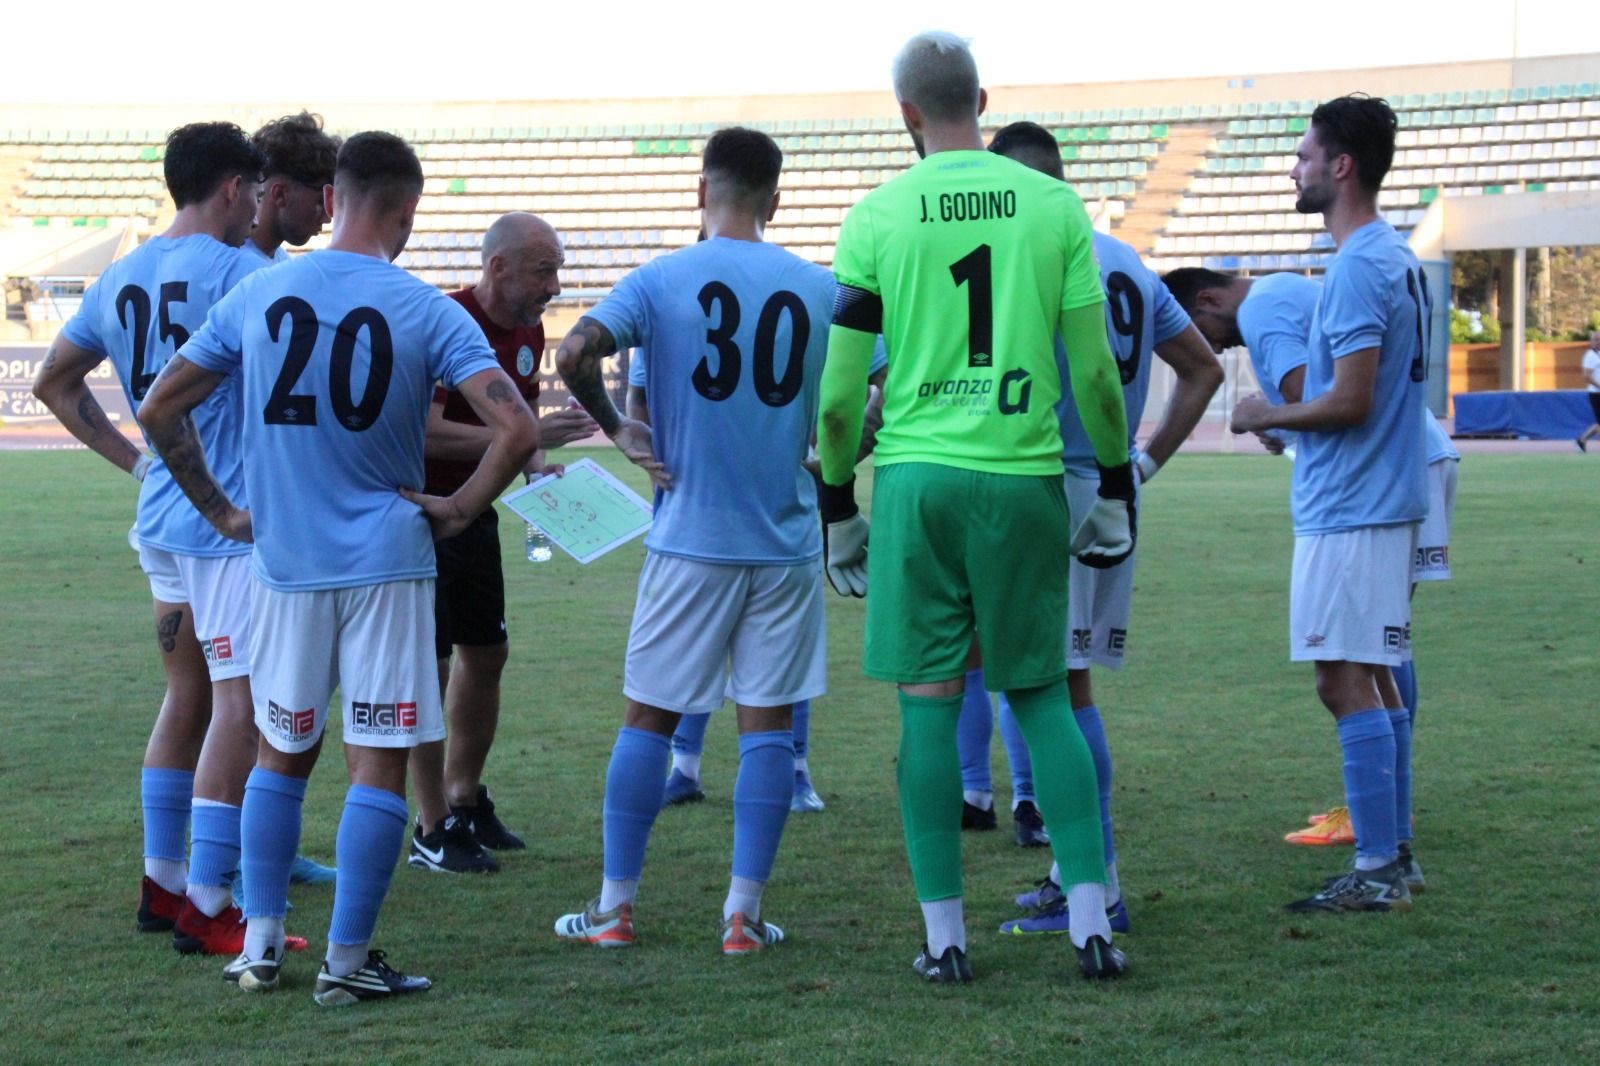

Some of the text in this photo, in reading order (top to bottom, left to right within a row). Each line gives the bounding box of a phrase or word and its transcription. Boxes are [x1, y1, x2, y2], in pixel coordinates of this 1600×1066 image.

[920, 189, 1016, 223] J. GODINO
[115, 281, 191, 401] 25
[263, 295, 394, 432] 20
[691, 281, 810, 407] 30
[949, 243, 993, 367] 1
[918, 379, 993, 398] avanza
